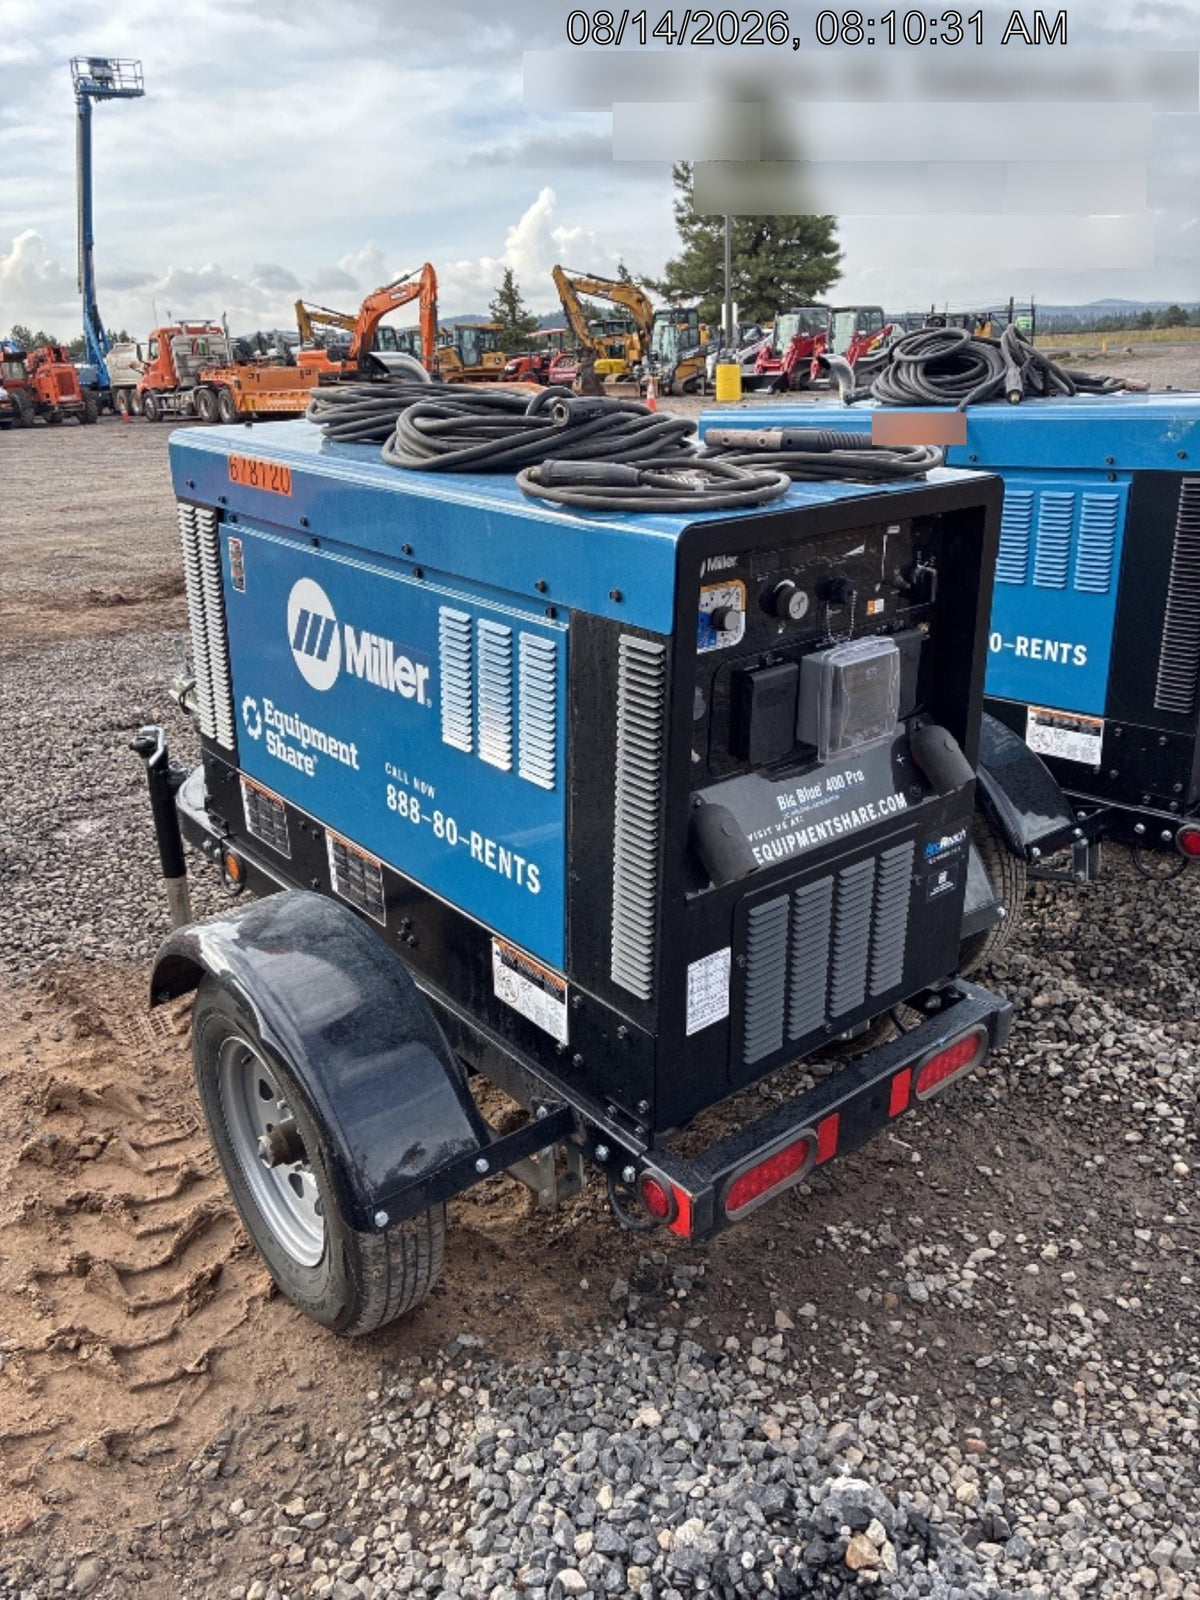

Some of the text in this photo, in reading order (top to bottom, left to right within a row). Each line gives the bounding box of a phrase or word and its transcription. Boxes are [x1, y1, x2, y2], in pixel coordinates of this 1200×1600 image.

[344, 623, 430, 705] Miller
[263, 697, 360, 770] Equipment
[266, 730, 315, 777] Share
[385, 762, 436, 799] CALL NOW
[796, 784, 821, 803] Blue
[386, 783, 541, 894] 888-80-RENTS
[752, 792, 908, 865] EQUIPMENTSHARE.COM
